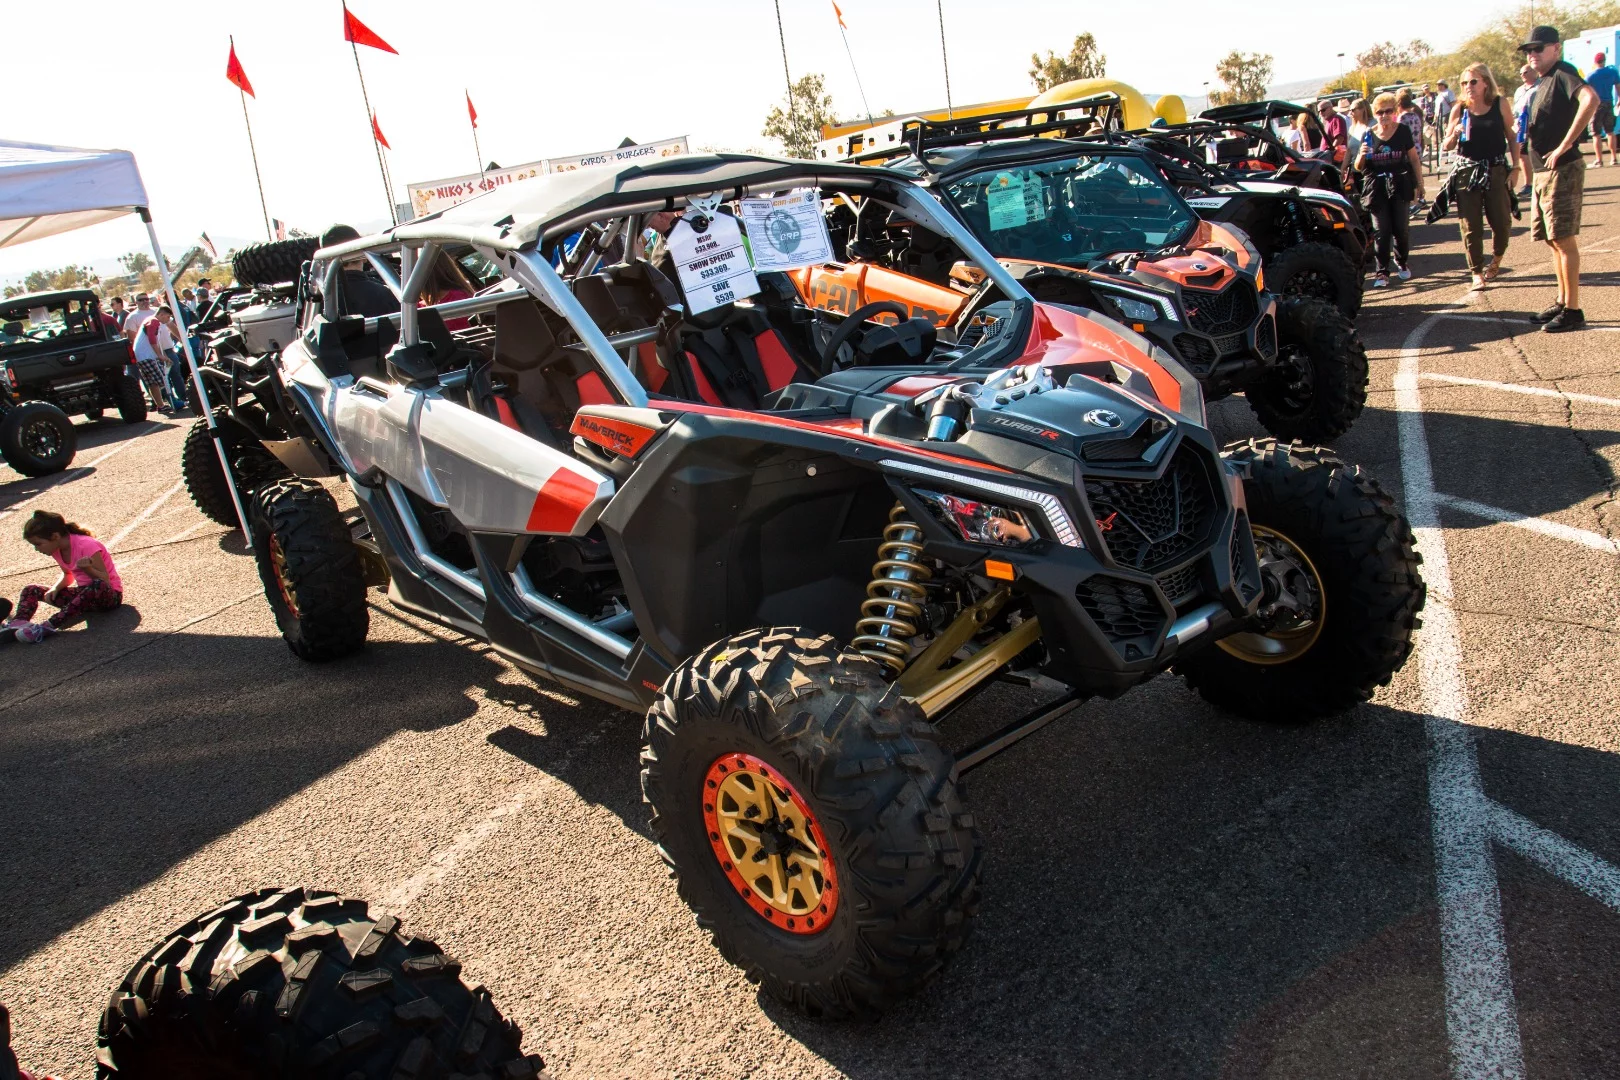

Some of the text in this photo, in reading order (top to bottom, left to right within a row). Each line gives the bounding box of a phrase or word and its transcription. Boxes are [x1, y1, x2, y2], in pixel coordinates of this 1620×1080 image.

[581, 155, 607, 166] GYROS
[616, 146, 656, 161] BURGERS
[436, 181, 474, 199] NIKO'S
[688, 250, 735, 272] SHOW SPECIAL
[712, 281, 730, 293] SAVE
[715, 291, 735, 304] $539
[579, 418, 635, 446] MAVERICK
